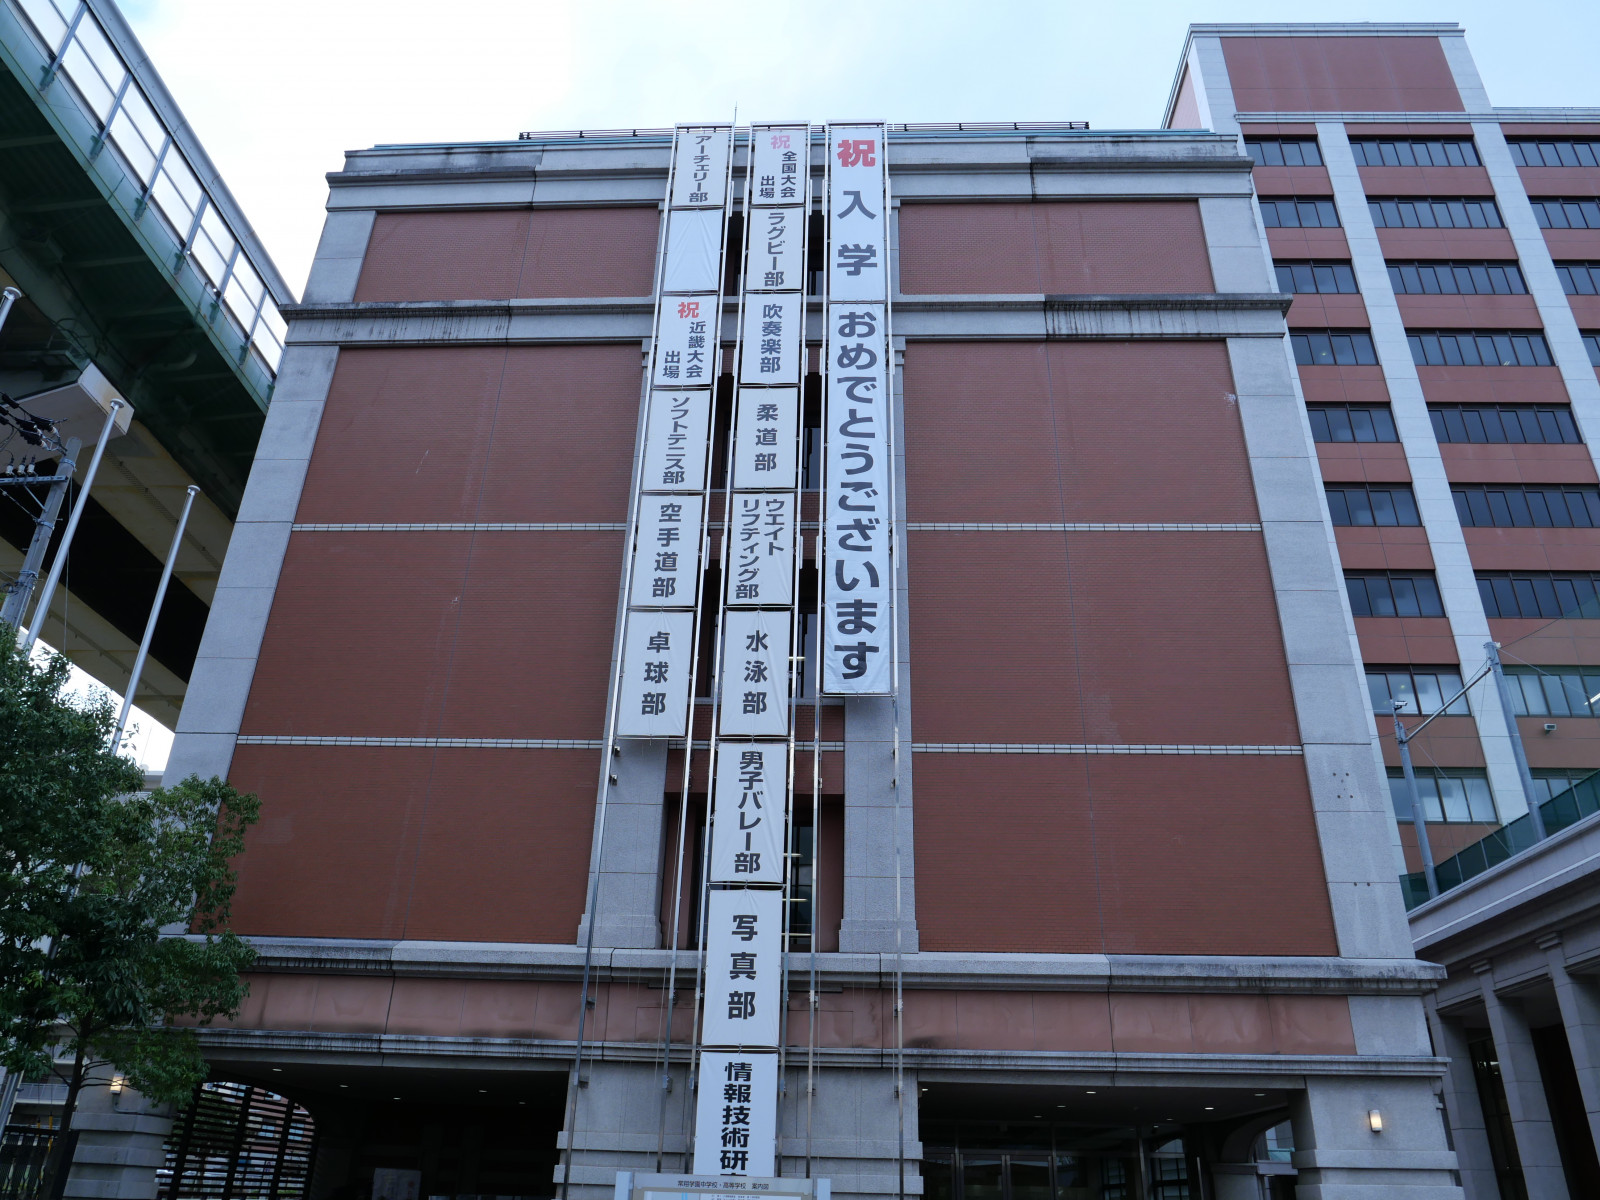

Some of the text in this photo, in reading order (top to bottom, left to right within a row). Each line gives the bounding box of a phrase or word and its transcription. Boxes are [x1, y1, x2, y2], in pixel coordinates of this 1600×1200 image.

[688, 135, 712, 203] アーチェリー部
[770, 135, 791, 149] 祝
[780, 150, 797, 198] 全国大会
[759, 175, 775, 198] 出場
[764, 212, 786, 287] ラグビー部
[677, 301, 700, 319] 祝
[759, 303, 783, 374] 吹奏楽部
[662, 350, 681, 379] 出場
[686, 320, 706, 379] 近畿大会
[662, 396, 691, 485] ソフトテニス部
[754, 403, 779, 472] 柔道部
[652, 502, 683, 598] 空手道部
[735, 498, 761, 600] リフティング部
[641, 630, 671, 715] 卓球部
[742, 629, 769, 715] 水泳部
[734, 750, 764, 874] 男子バレー部
[727, 914, 758, 1020] 写真部
[719, 1061, 753, 1177] 情報技術研
